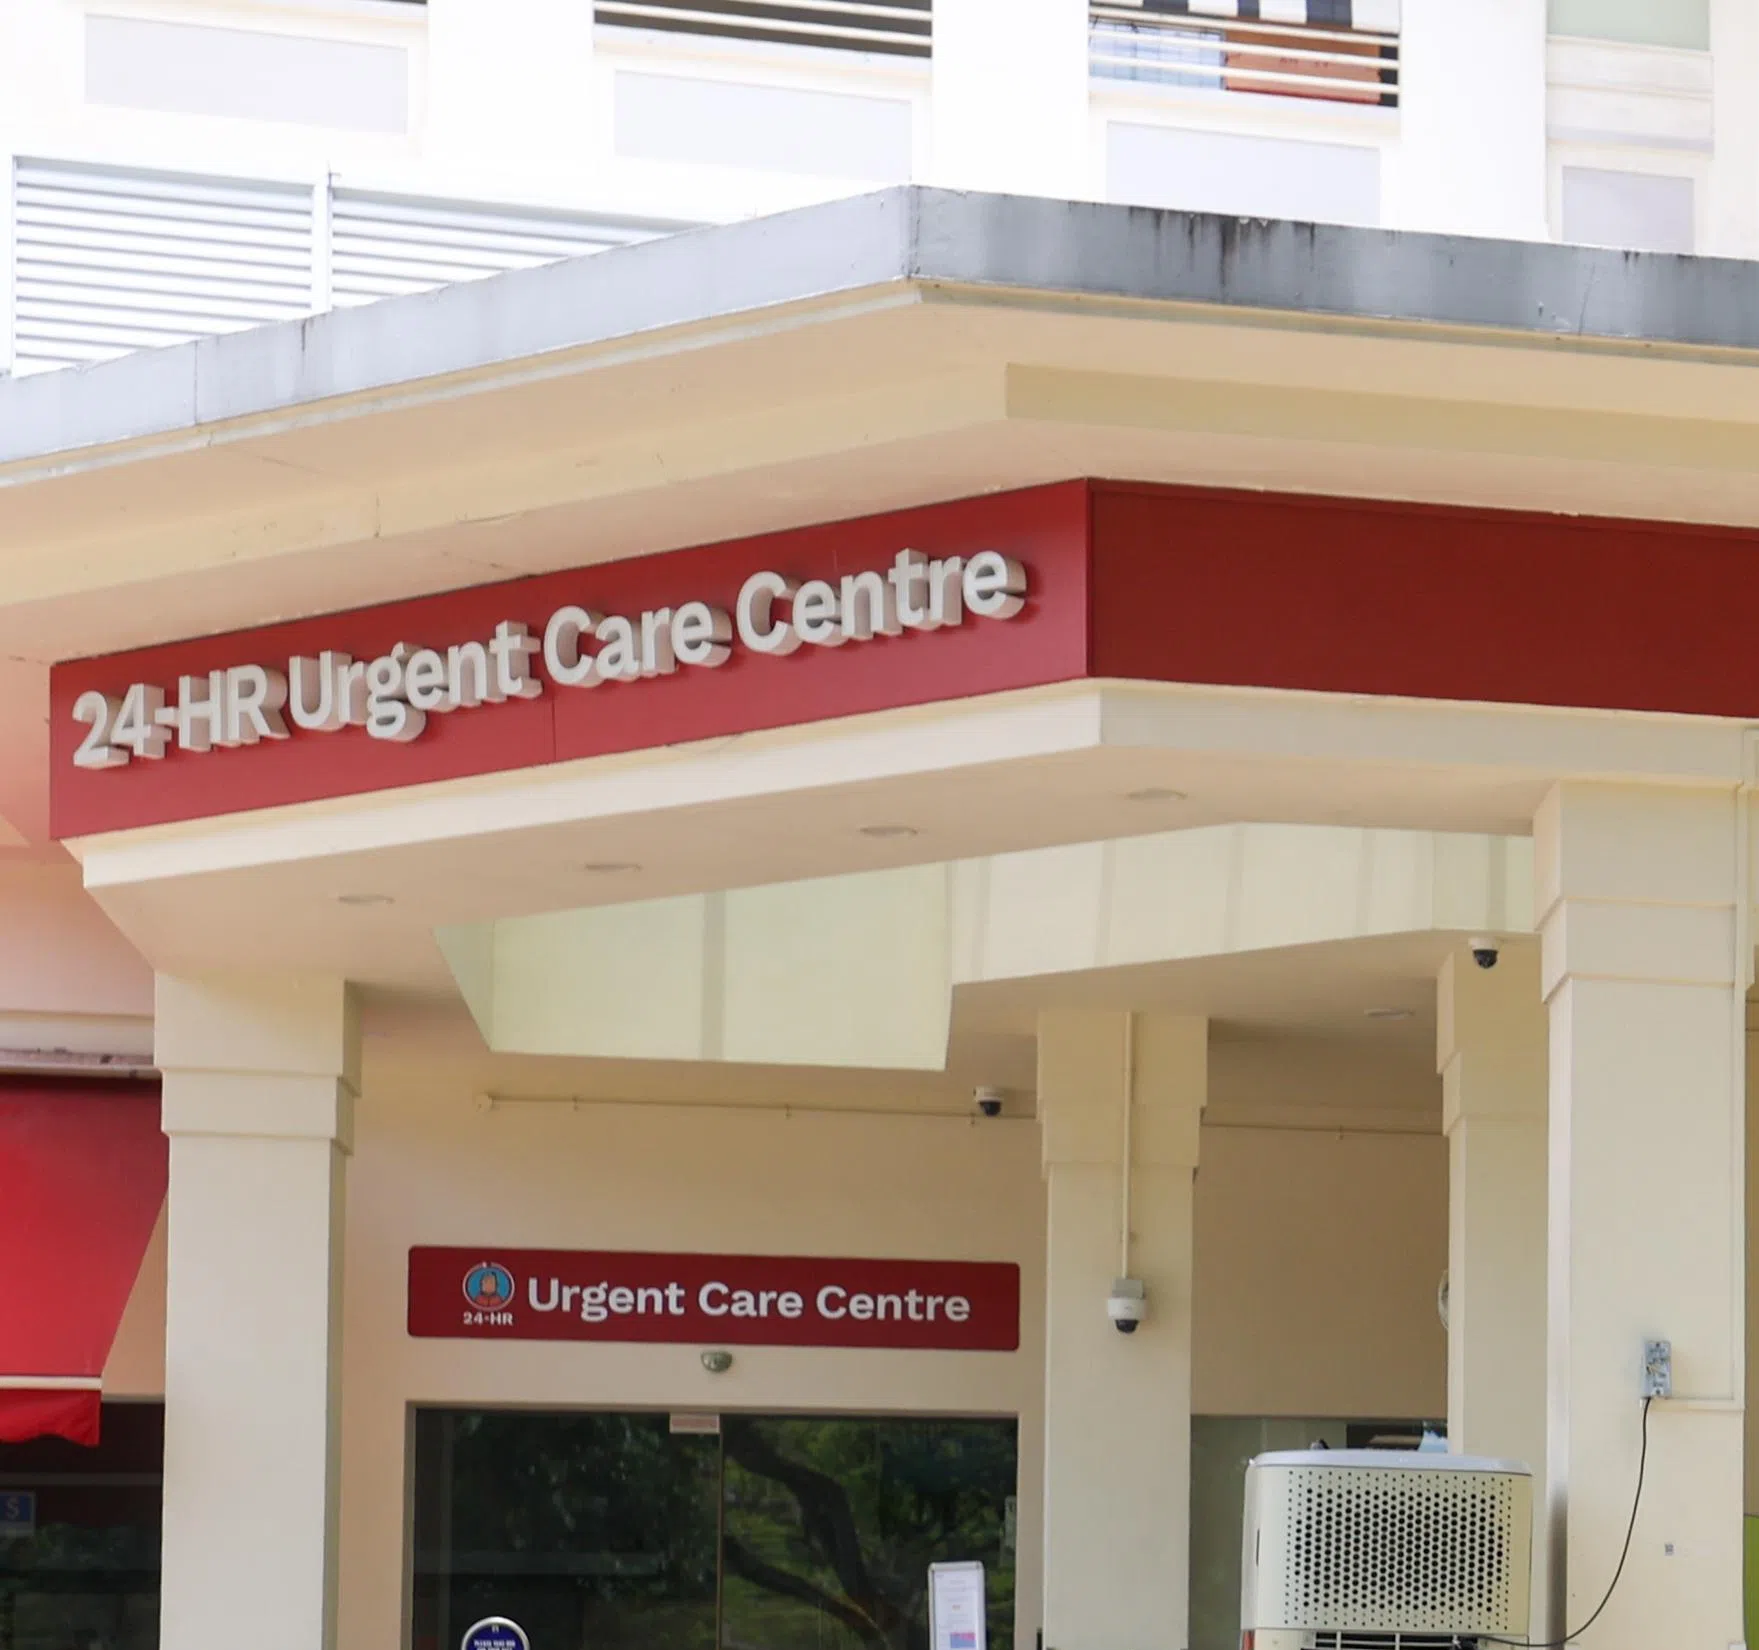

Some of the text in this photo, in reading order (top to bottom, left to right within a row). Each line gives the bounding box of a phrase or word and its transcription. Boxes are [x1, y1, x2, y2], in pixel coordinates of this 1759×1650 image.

[72, 548, 1026, 769] 24-HR Urgent Care Centre
[462, 1311, 514, 1326] 24-HR
[527, 1277, 971, 1322] Urgent Care Centre
